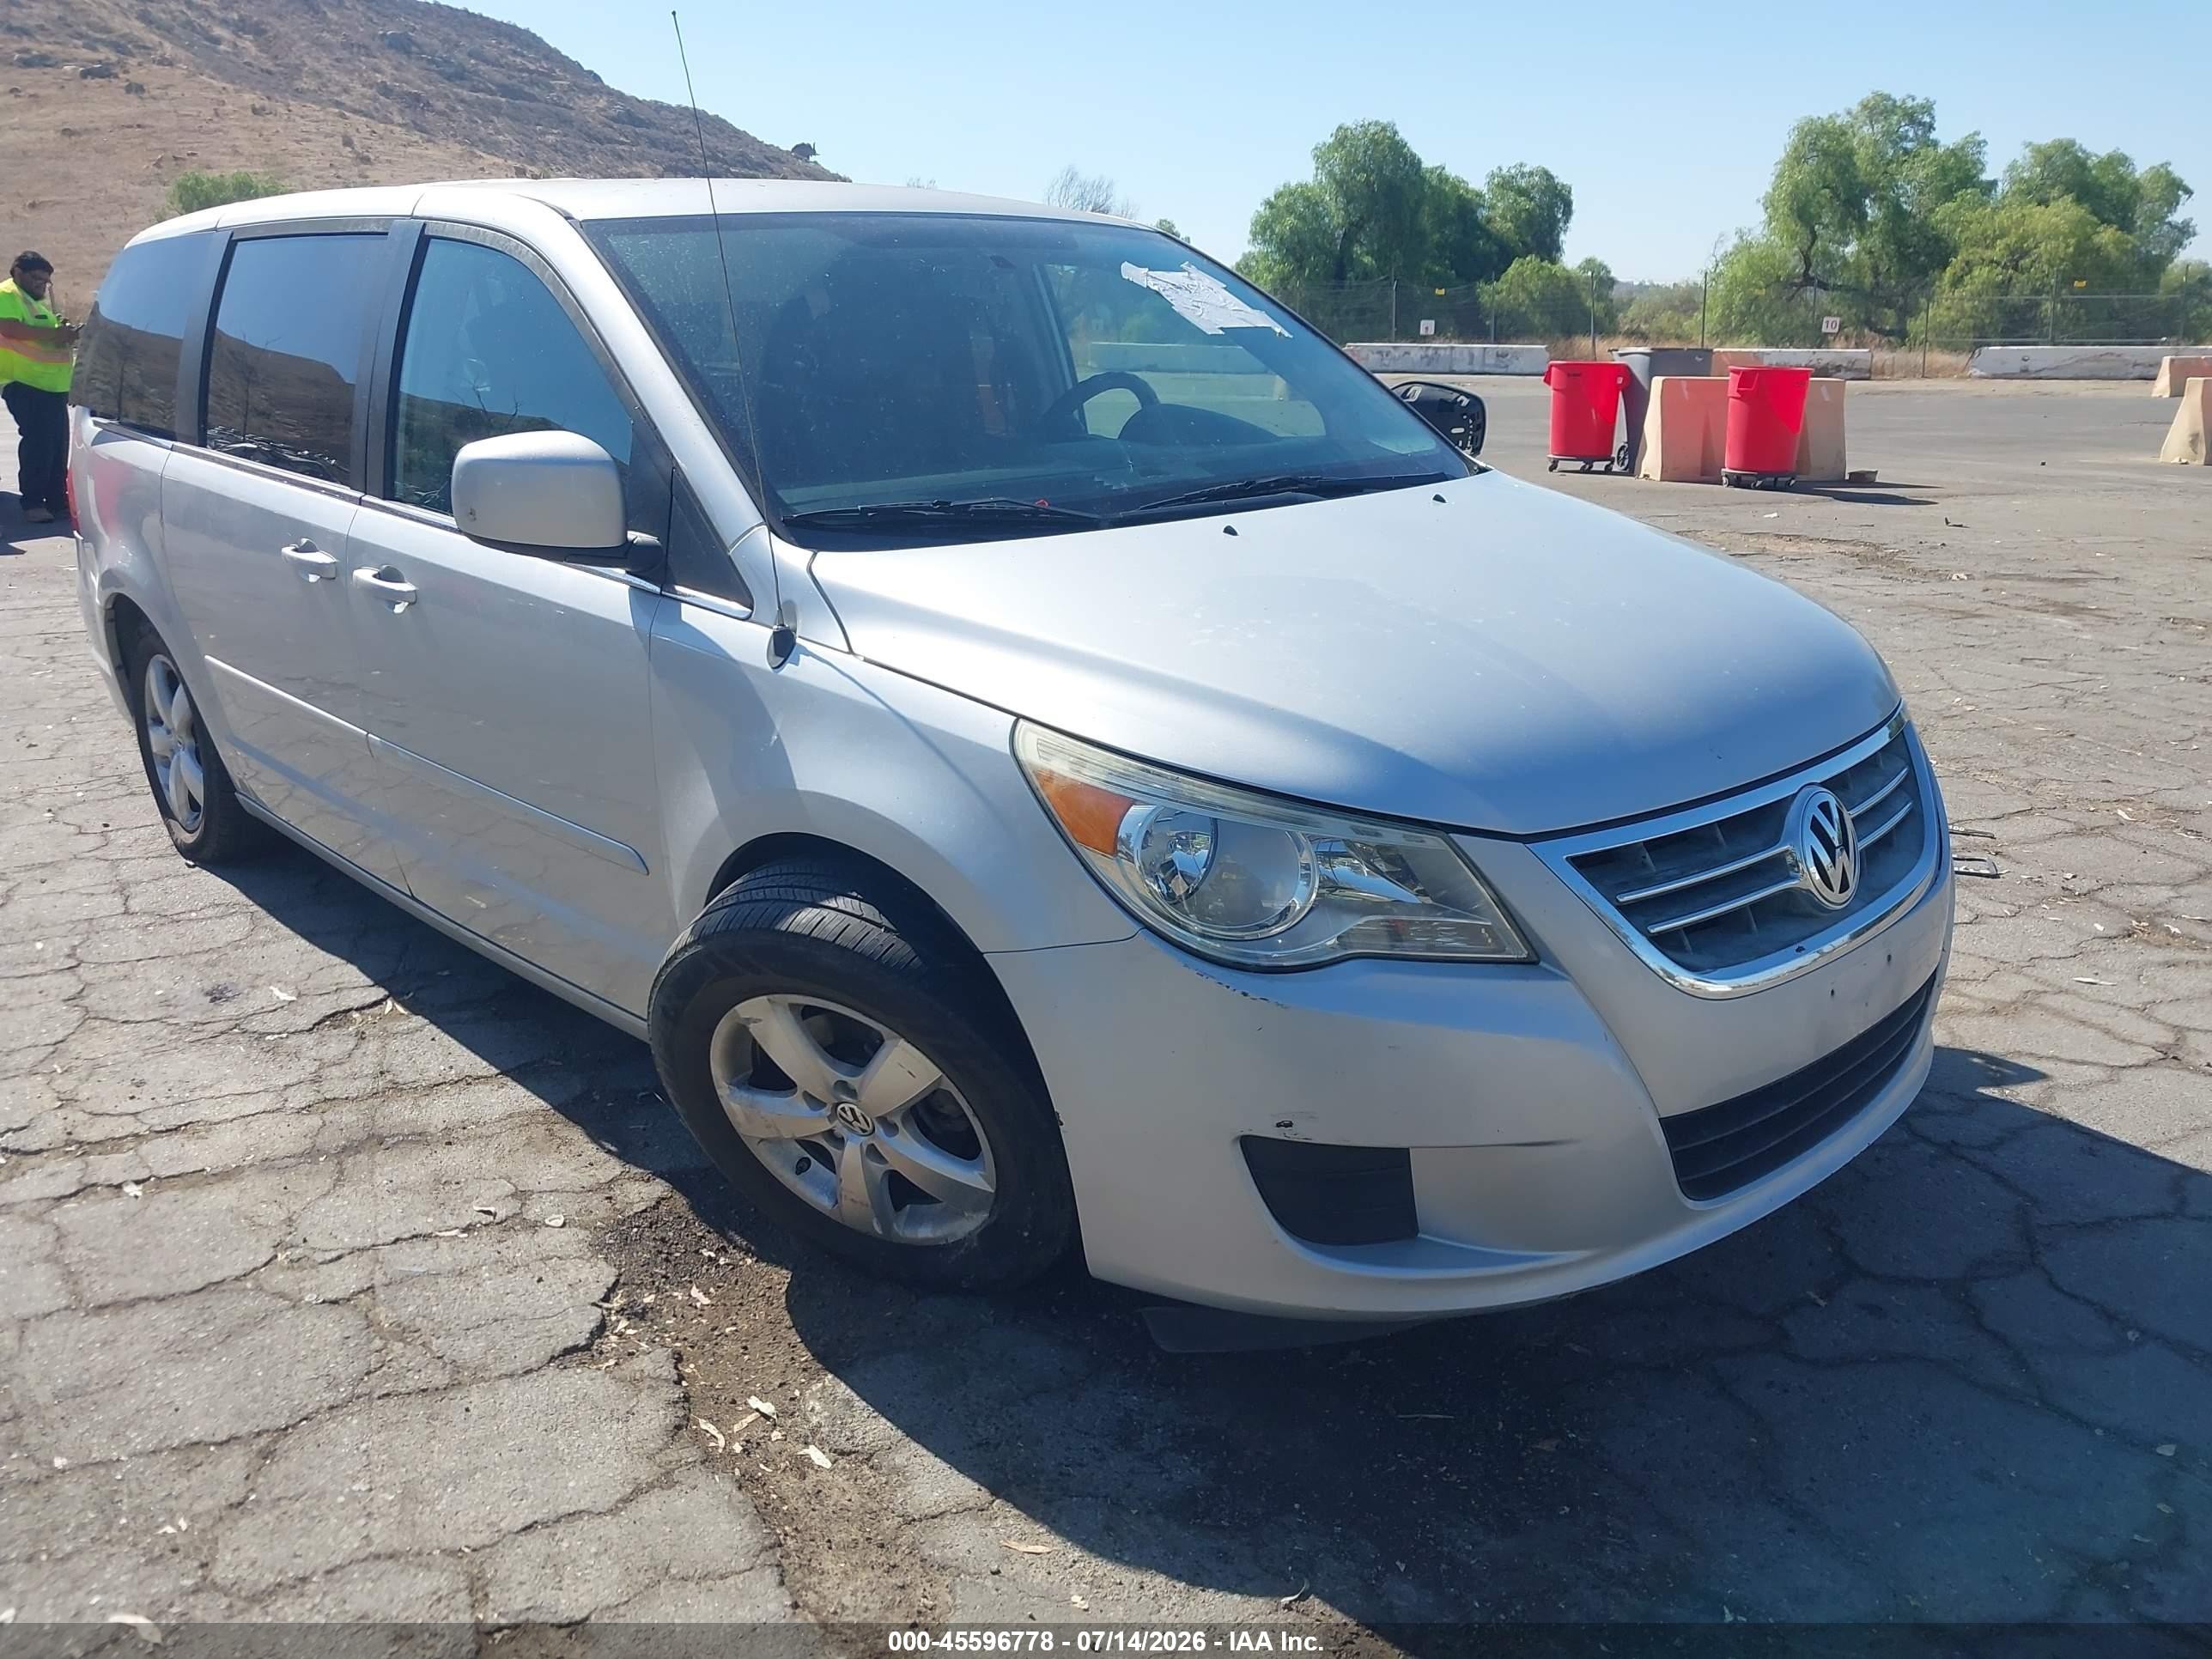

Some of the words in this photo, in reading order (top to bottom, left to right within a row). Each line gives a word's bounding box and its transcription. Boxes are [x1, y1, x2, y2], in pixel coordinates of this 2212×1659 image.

[1824, 319, 1838, 331] 10
[1804, 793, 1858, 902] VW
[838, 1104, 873, 1134] VW
